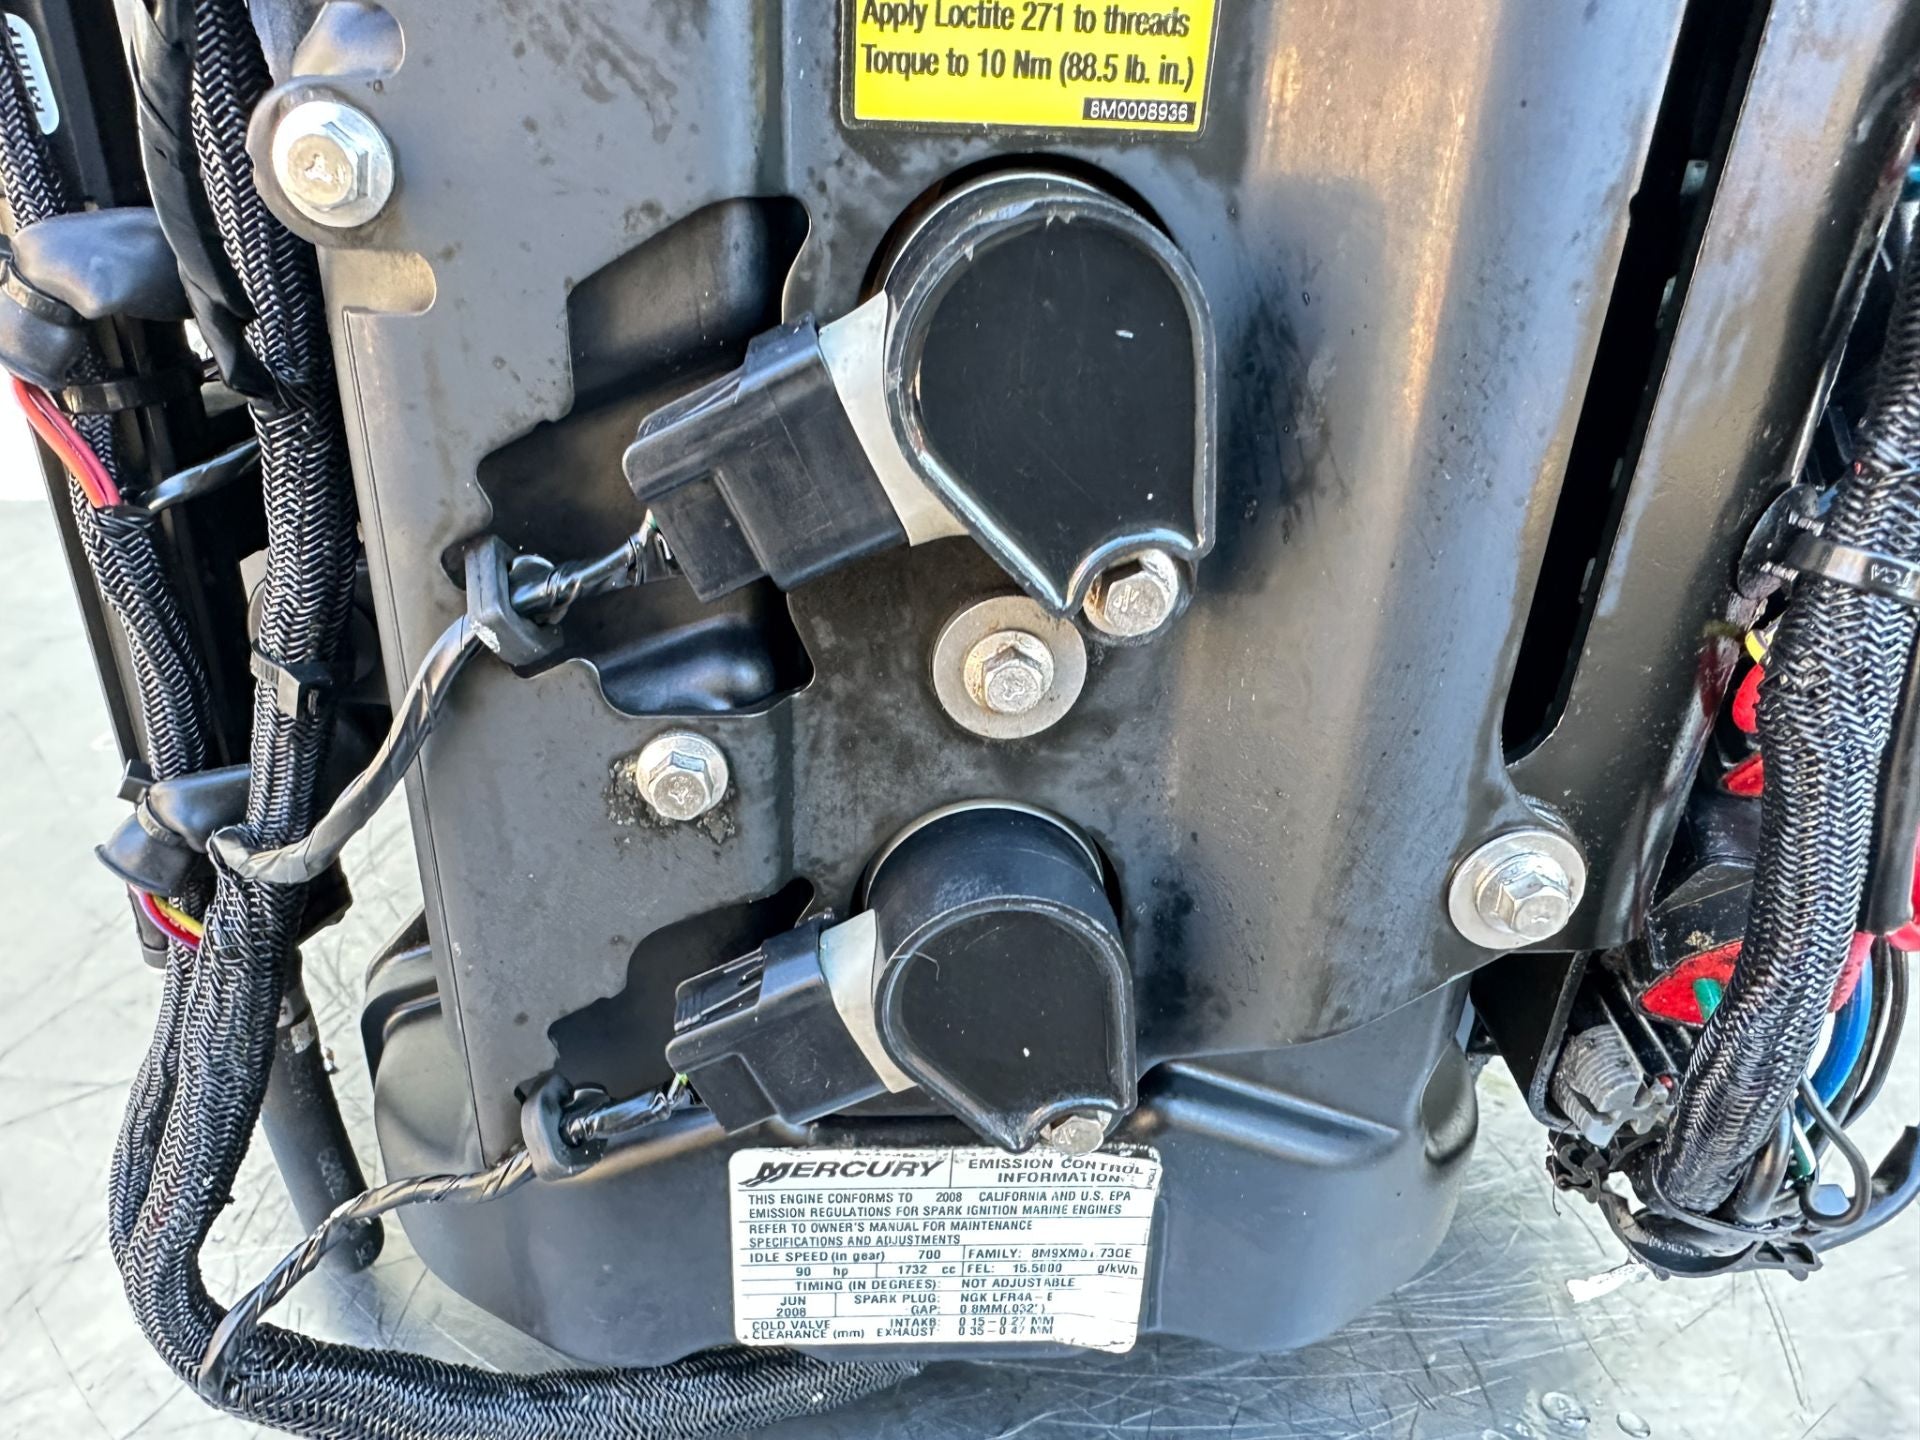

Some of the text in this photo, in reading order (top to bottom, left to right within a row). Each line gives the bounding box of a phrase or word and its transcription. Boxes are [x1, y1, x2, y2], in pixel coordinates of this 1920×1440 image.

[861, 0, 1191, 38] Apply Loctite 271 to threads
[861, 43, 1194, 93] Torque to 10 Nm (88.5 lb. in.)
[1090, 100, 1188, 122] 8M0008936
[968, 1158, 1144, 1174] EMISSION CONTROL
[738, 1160, 944, 1187] MERCURY
[998, 1172, 1120, 1183] INFORMATION
[748, 1191, 1131, 1205] THIS ENGINE CONFORMS TO 2008 CALIFORNIA AND U.S. EPA
[749, 1204, 1122, 1218] EMISSION REGULATIONS FOR SPARK IGNITION MARINE ENGINES
[749, 1220, 1033, 1234] REFER TO OWNER'S MANUAL FOR MAINTENANCE
[749, 1234, 961, 1248] SPECIFICATIONS AND ADJUSTMENTS
[750, 1252, 780, 1263] IDLE
[785, 1251, 828, 1262] SPEED
[852, 1250, 885, 1263] gear)
[919, 1249, 941, 1260] 700
[968, 1248, 1023, 1259] FAMILY:
[796, 1266, 849, 1278] 90 hp
[898, 1265, 956, 1275] 1732 cc
[967, 1263, 1138, 1275] FEL: 15.5000 g/kWh
[795, 1280, 843, 1291] TIMING
[848, 1280, 867, 1292] (IN
[961, 1278, 987, 1288] NOT
[992, 1277, 1076, 1288] ADJUSTABLE
[780, 1296, 807, 1306] JUN
[854, 1294, 897, 1304] SPARK
[902, 1292, 941, 1304] PLUG:
[960, 1292, 988, 1302] NGK
[776, 1308, 807, 1318] 2008
[752, 1320, 831, 1331] COLD VALVE
[752, 1328, 865, 1340] CLEARANCE (mm)
